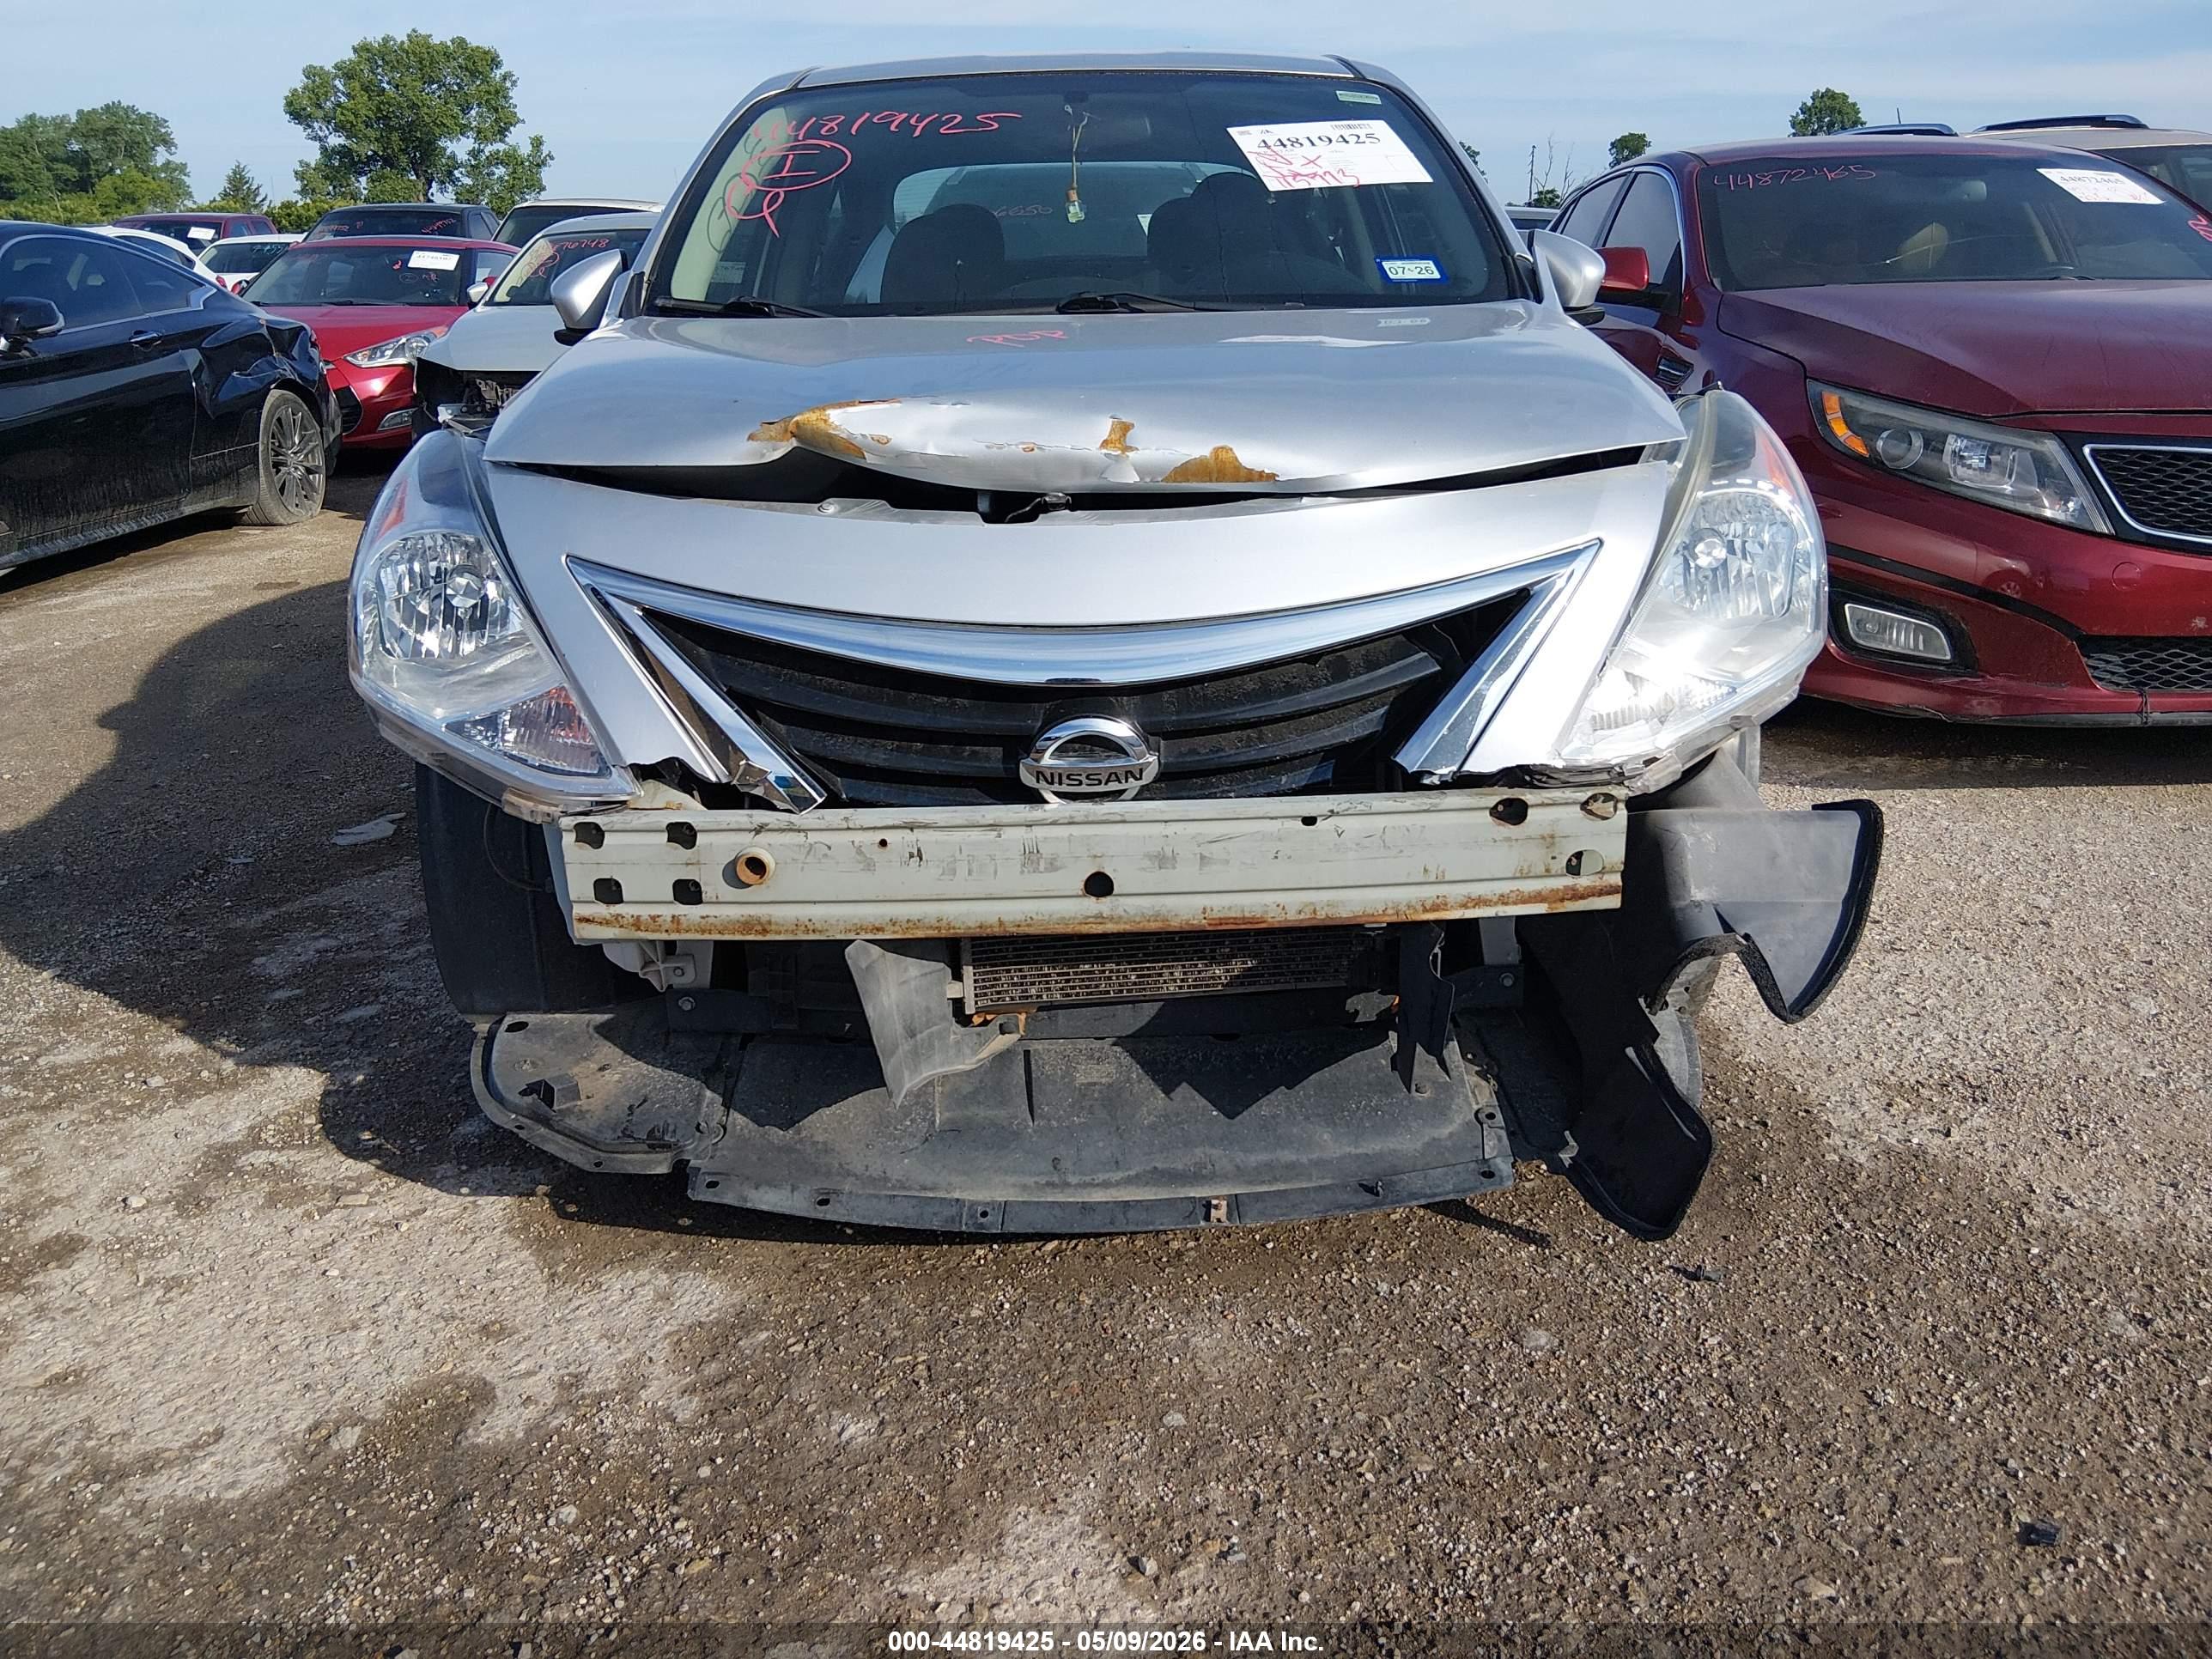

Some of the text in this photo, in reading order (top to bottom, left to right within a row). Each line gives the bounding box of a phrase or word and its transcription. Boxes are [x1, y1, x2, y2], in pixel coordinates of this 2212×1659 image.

[1256, 132, 1381, 150] 44819425
[1388, 265, 1435, 276] 07 26
[1035, 767, 1145, 787] NISSAN
